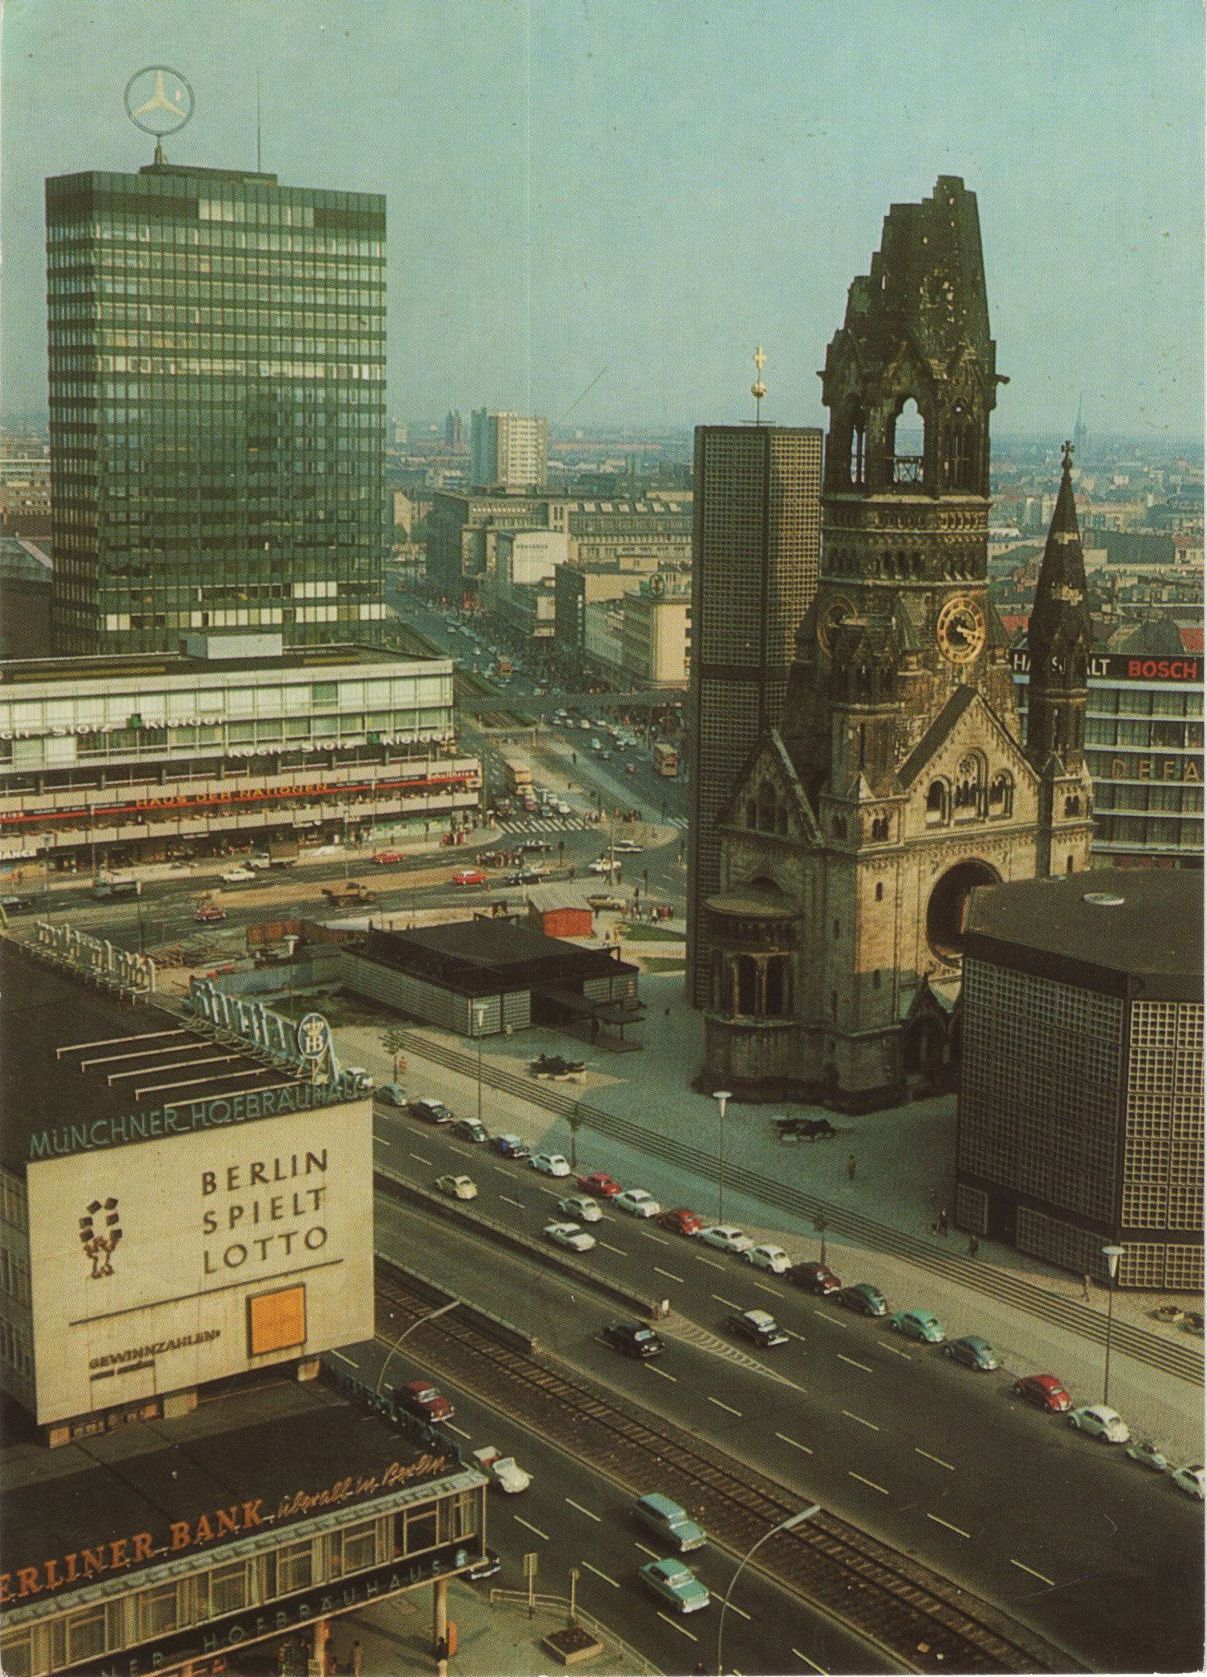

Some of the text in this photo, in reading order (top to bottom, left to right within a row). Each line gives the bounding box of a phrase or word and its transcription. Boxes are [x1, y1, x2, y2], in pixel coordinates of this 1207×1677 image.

[1128, 660, 1198, 679] BOSCH
[136, 795, 188, 808] HAUS
[196, 793, 231, 802] DER
[239, 784, 328, 800] NATIONEN
[202, 1149, 327, 1196] BERLIN
[203, 1187, 327, 1235] SPIELT
[204, 1226, 328, 1274] LOTTO
[168, 1499, 264, 1550] BANK
